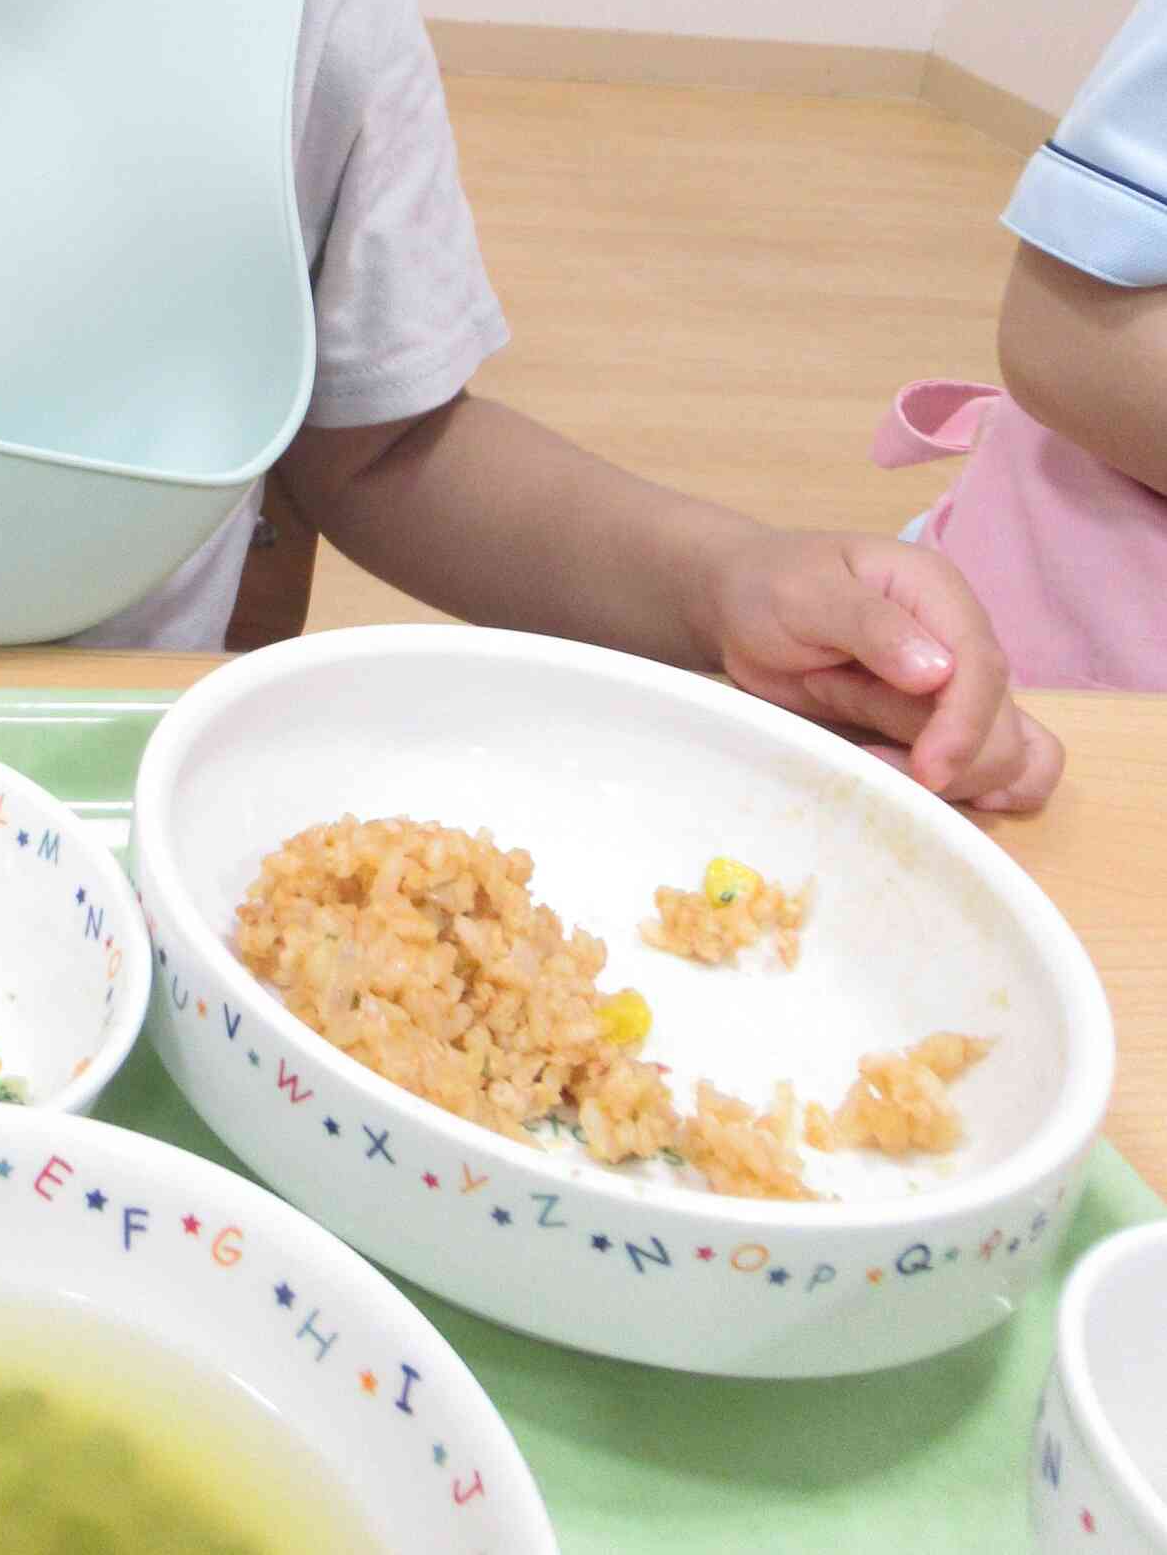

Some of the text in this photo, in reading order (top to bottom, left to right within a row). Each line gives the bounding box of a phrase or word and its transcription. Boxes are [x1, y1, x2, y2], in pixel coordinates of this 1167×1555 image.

[37, 829, 60, 866] M
[85, 904, 104, 940] N
[224, 1002, 242, 1041] V
[277, 1058, 314, 1104] W
[363, 1124, 396, 1165] X
[531, 1193, 568, 1228] Z
[624, 1236, 672, 1274] N
[730, 1244, 770, 1272] O
[807, 1264, 836, 1292] P
[895, 1243, 934, 1277] Q
[34, 1155, 74, 1202] E
[123, 1205, 150, 1252] F
[213, 1226, 242, 1267] G
[297, 1309, 338, 1362] H
[395, 1362, 422, 1417] I
[452, 1469, 484, 1506] J
